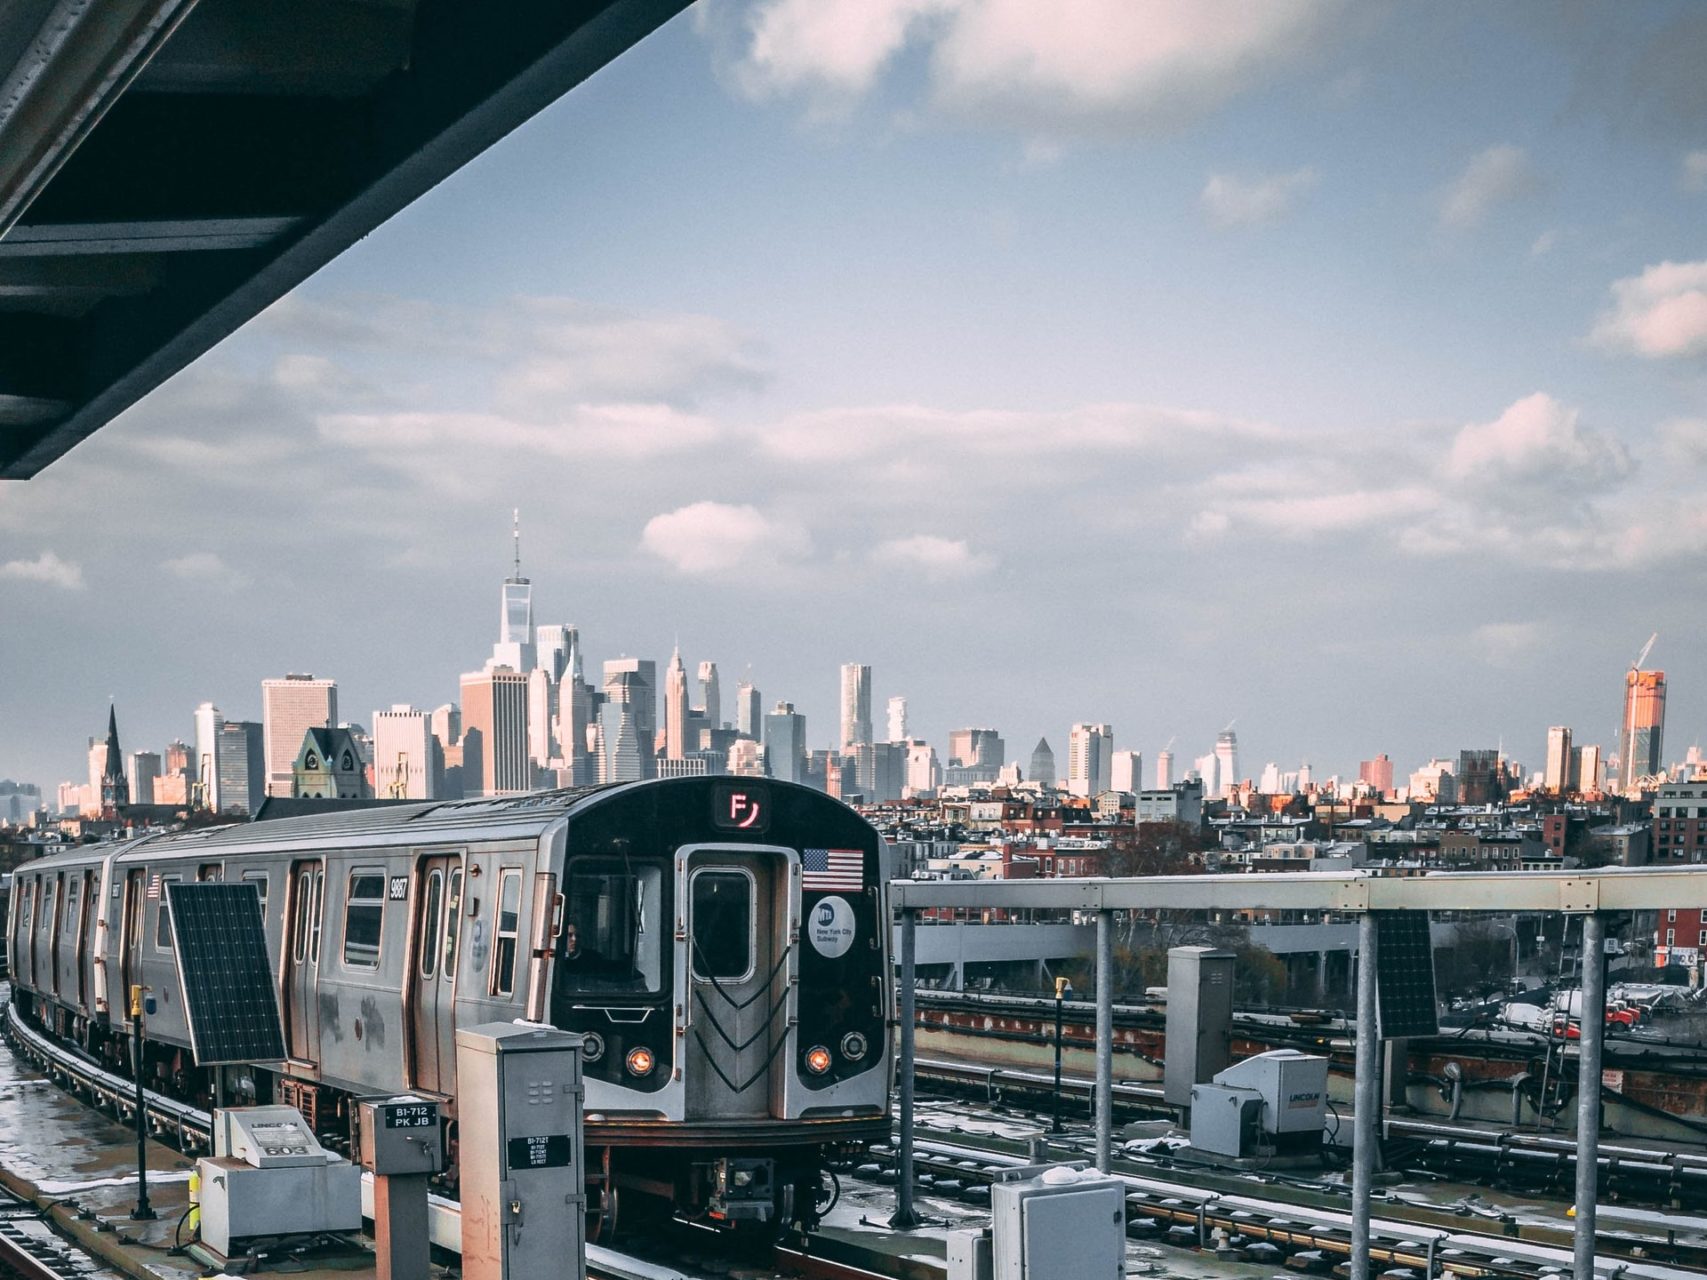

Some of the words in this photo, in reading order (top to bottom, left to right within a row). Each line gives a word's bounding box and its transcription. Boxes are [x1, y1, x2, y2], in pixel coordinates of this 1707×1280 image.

[731, 794, 746, 819] F
[841, 928, 852, 937] City
[816, 935, 838, 944] Subway
[1289, 1092, 1320, 1102] LINCOLN
[395, 1118, 410, 1127] PK
[414, 1117, 429, 1126] JB
